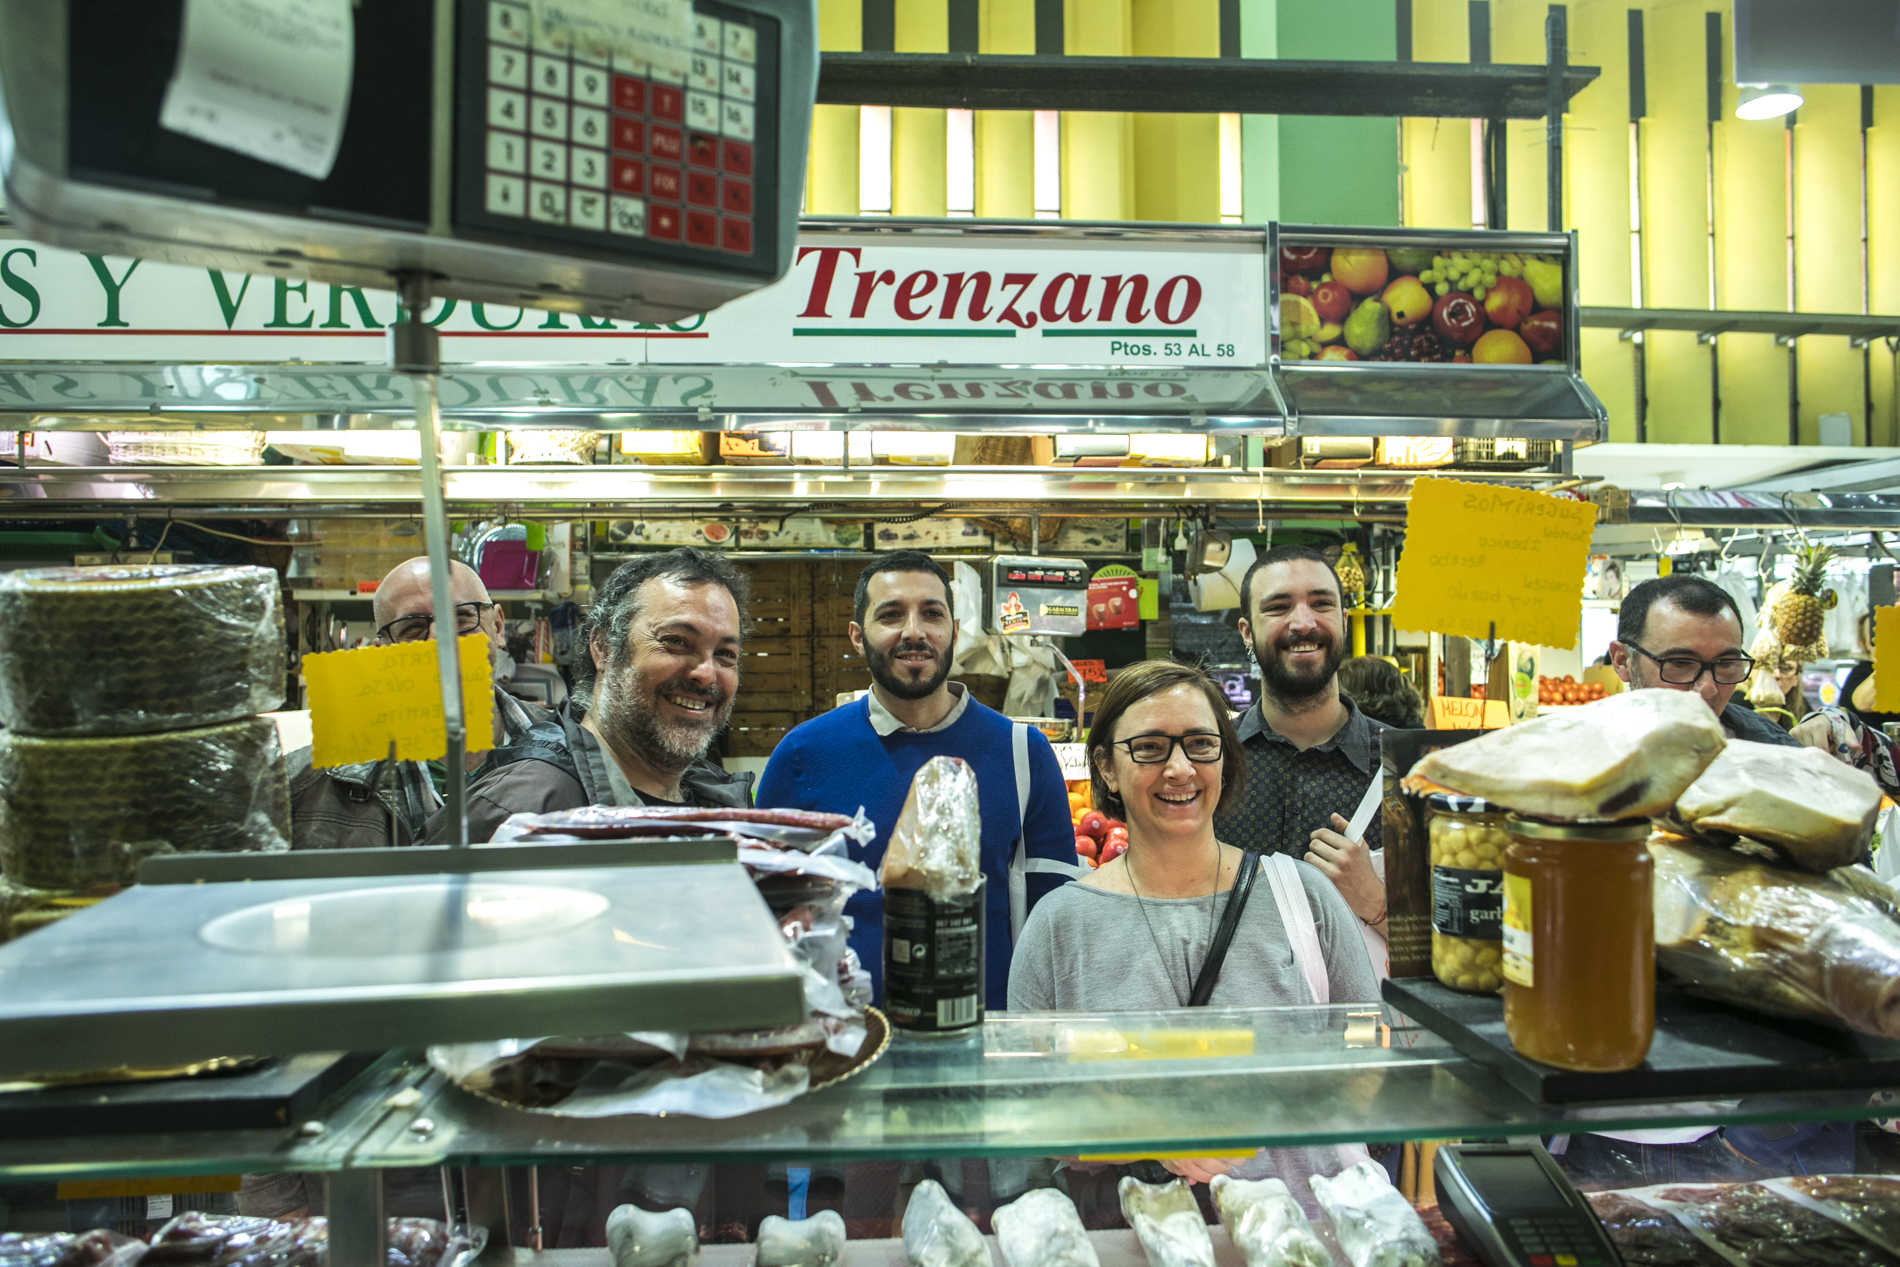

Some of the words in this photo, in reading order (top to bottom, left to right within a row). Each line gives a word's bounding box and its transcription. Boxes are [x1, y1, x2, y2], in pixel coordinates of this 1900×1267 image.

[502, 56, 516, 76] 7
[545, 66, 558, 87] 8
[584, 75, 599, 95] 9
[501, 100, 516, 120] 4
[542, 108, 557, 129] 5
[583, 118, 598, 138] 6
[542, 151, 557, 172] 2
[582, 160, 597, 179] 3
[80, 250, 142, 328] Y
[796, 247, 1202, 329] Trenzano
[1110, 341, 1157, 356] Ptos.
[1164, 343, 1182, 356] 53
[1187, 343, 1211, 357] AL
[1216, 343, 1235, 358] 58
